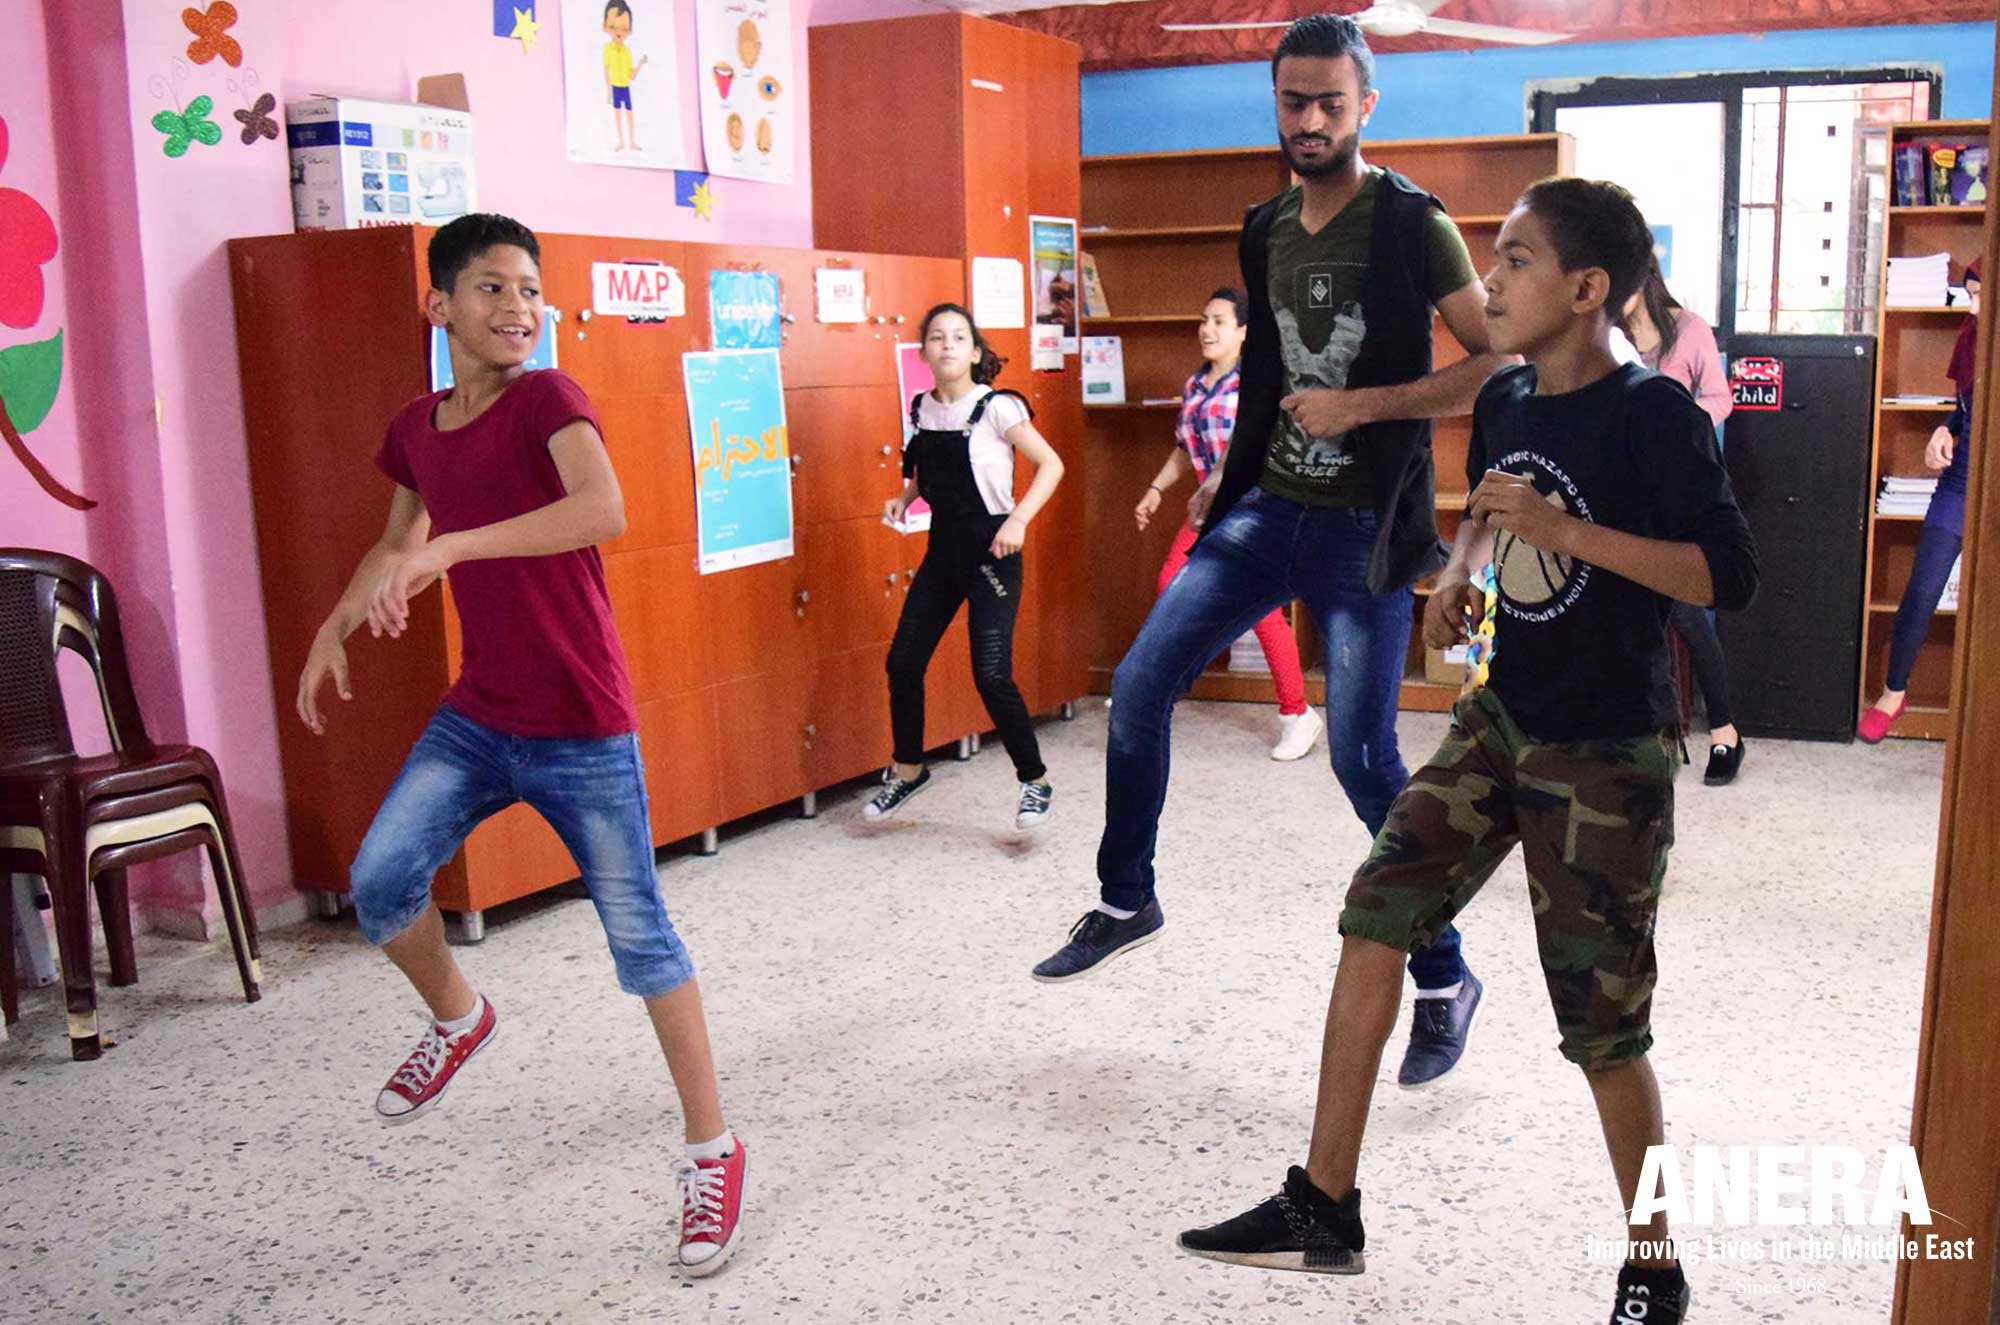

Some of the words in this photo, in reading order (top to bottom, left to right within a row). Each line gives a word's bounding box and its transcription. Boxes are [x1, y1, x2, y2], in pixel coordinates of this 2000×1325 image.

[608, 268, 670, 302] MAP
[1733, 385, 1776, 404] child
[696, 417, 789, 489] الاحترام
